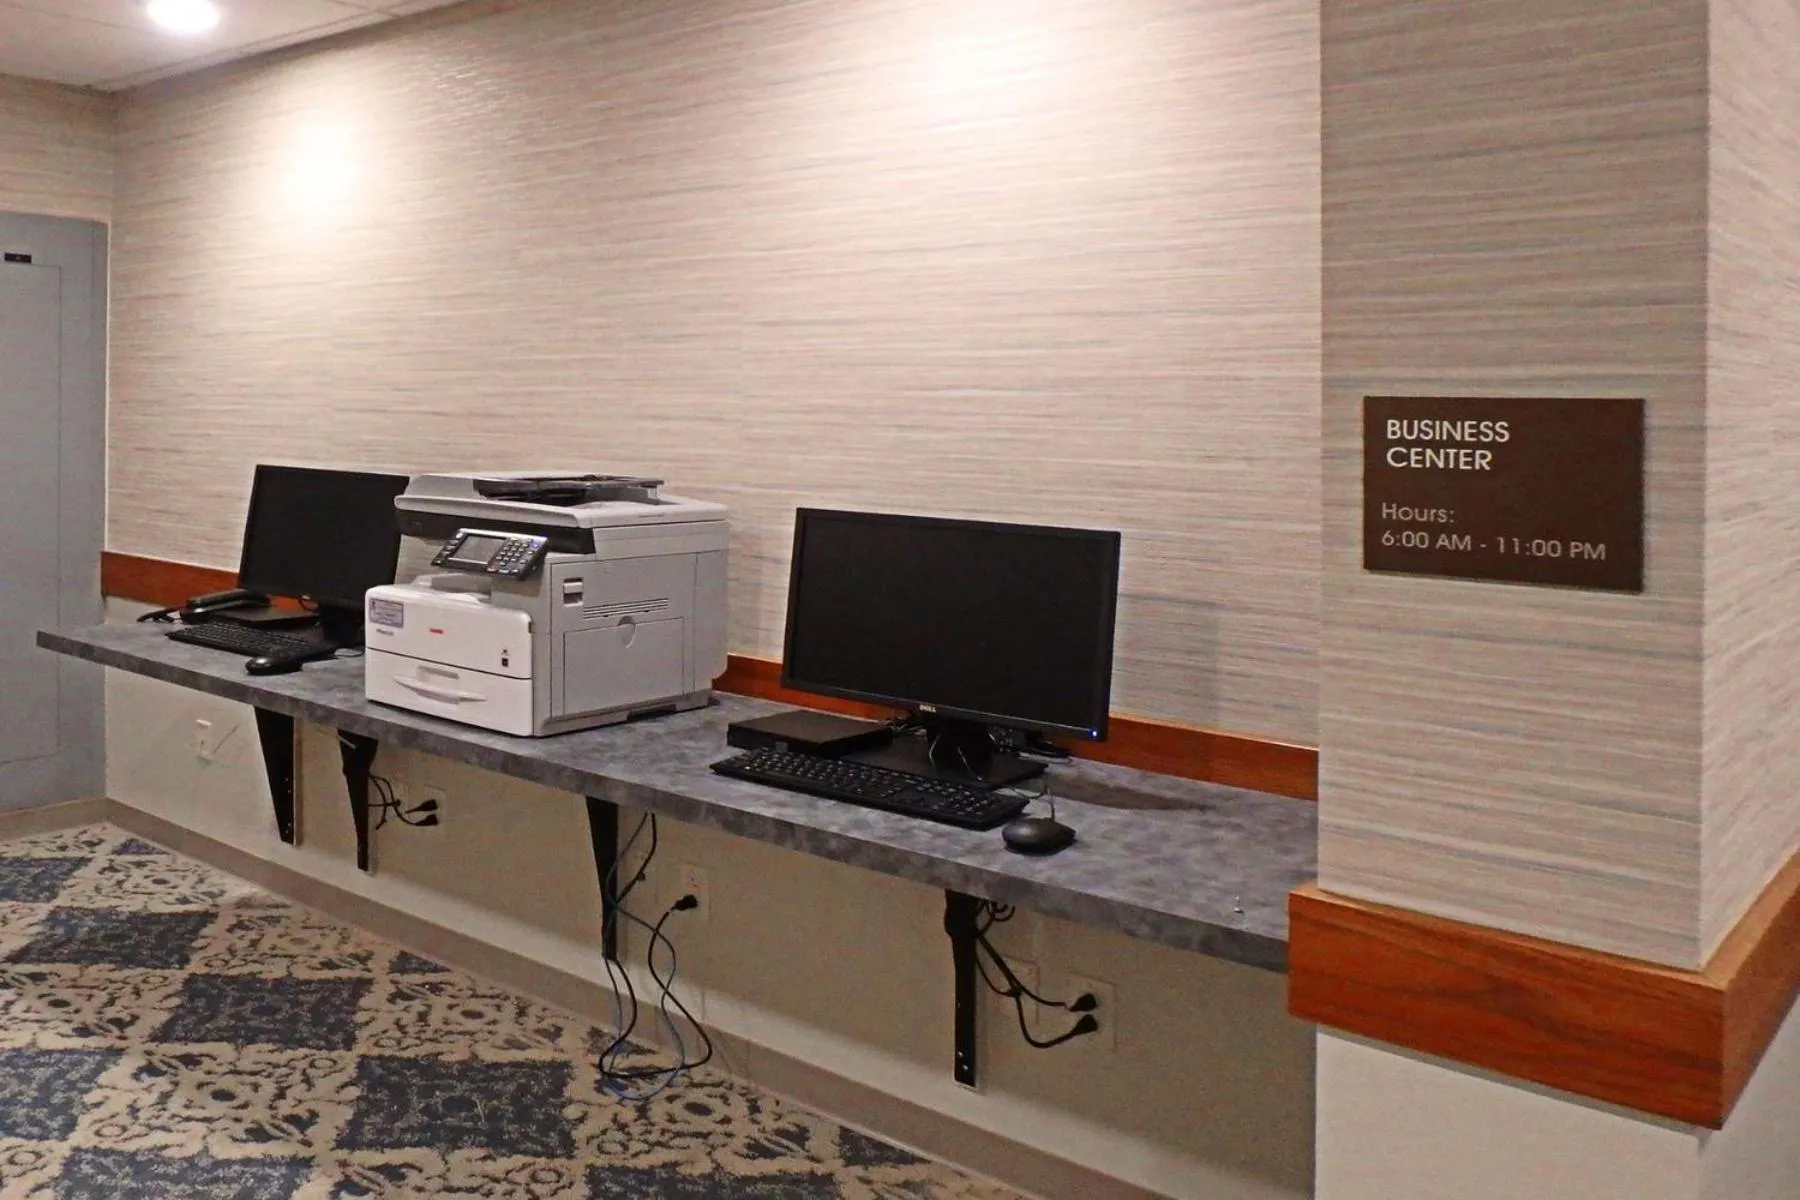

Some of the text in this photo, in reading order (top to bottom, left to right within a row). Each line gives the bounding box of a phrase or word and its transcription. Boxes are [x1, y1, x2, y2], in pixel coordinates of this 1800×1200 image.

[1387, 419, 1510, 442] BUSINESS
[1386, 446, 1493, 470] CENTER
[1382, 502, 1455, 523] Hours:
[1382, 530, 1430, 549] 6:00
[1435, 533, 1472, 551] AM
[1497, 536, 1561, 557] 11:00
[1570, 541, 1606, 560] PM
